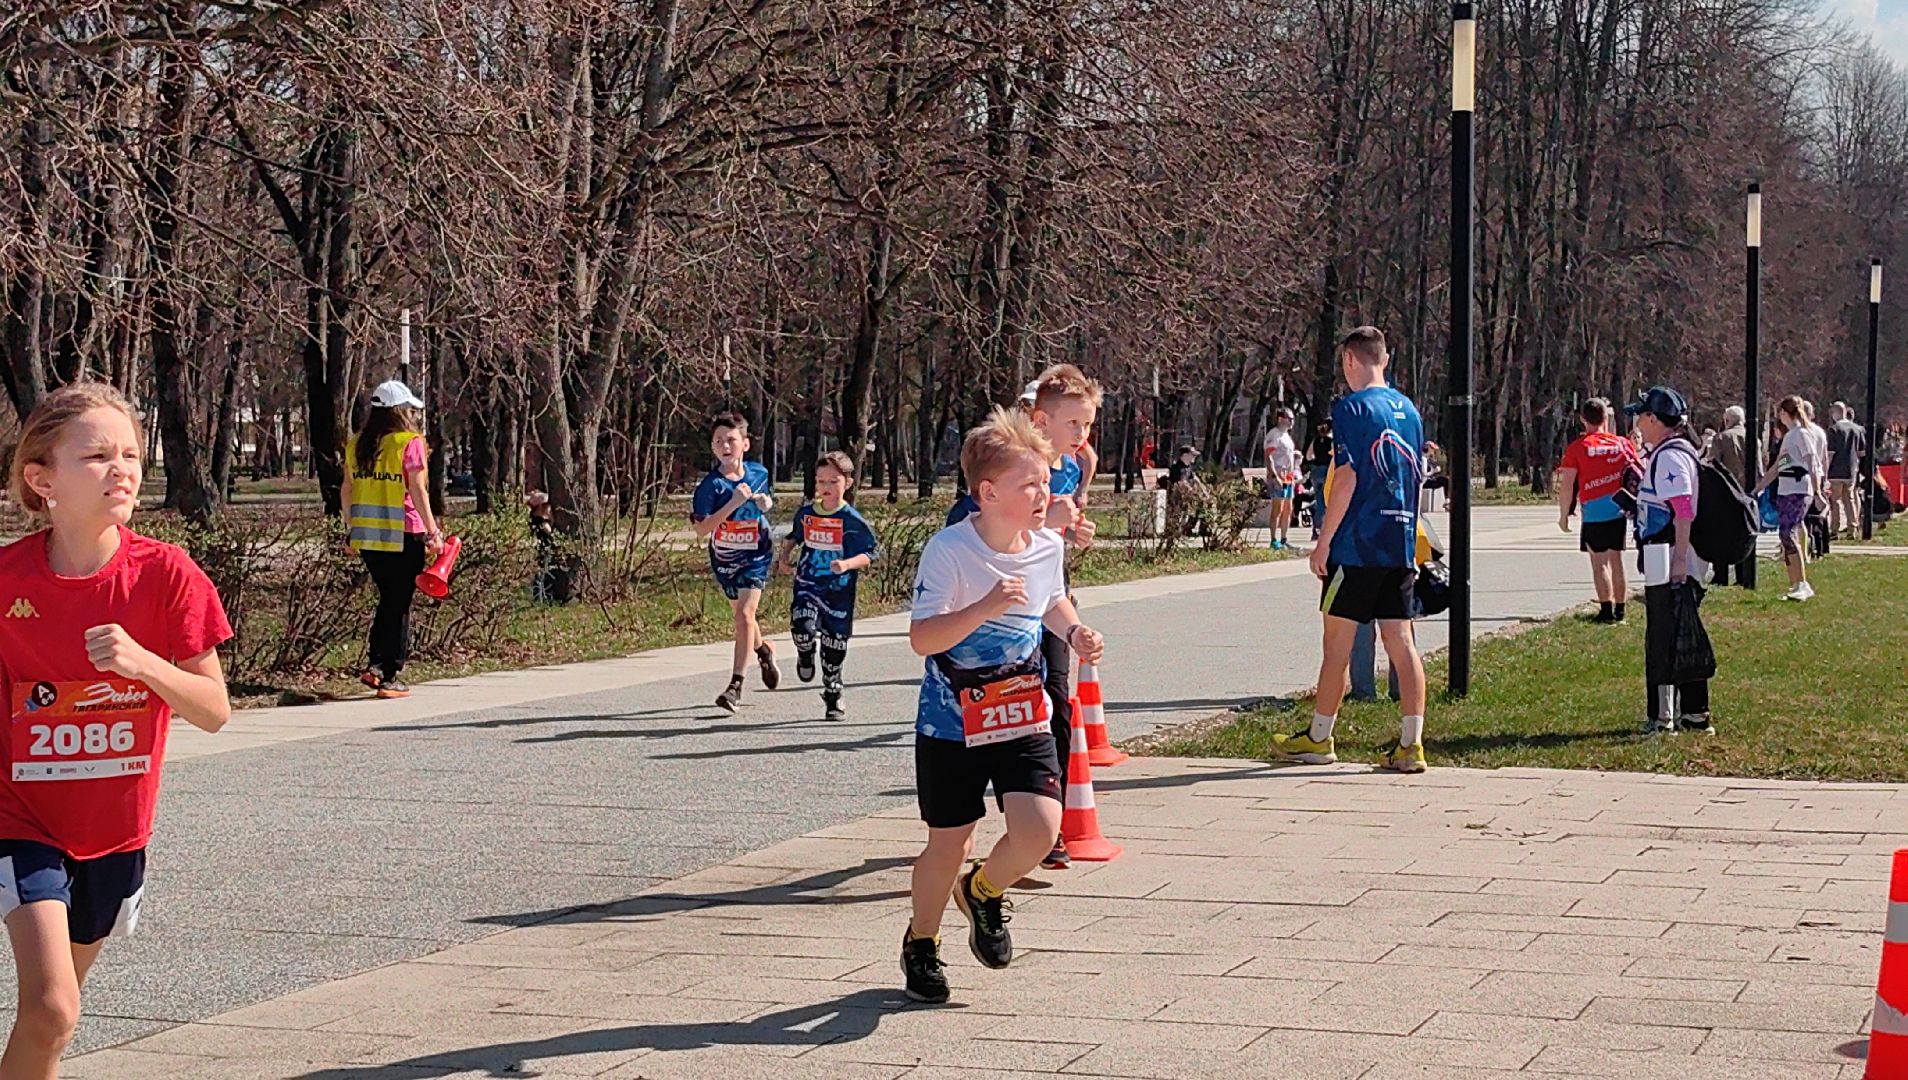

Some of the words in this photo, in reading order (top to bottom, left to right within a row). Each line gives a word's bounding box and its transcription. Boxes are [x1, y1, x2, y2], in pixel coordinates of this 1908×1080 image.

[720, 531, 753, 543] 2000
[821, 635, 847, 651] GOLDEN
[982, 700, 1033, 728] 2151
[30, 721, 134, 755] 2086
[121, 763, 125, 771] 1
